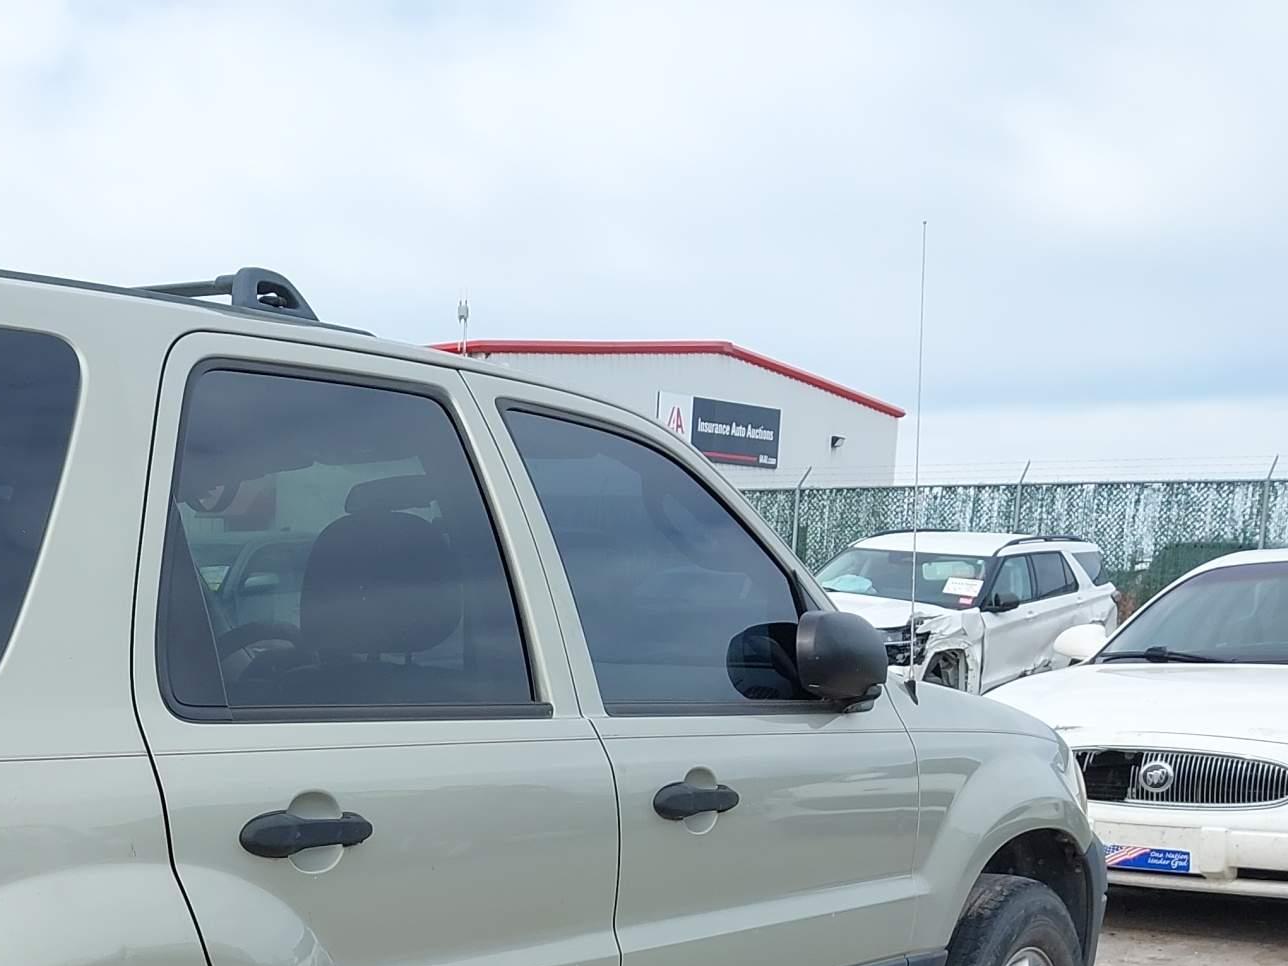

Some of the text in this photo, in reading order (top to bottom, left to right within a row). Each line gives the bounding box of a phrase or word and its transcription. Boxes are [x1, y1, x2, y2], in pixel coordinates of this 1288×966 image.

[697, 417, 774, 441] Insurance Auto Auctions
[1165, 852, 1188, 860] Nation
[1147, 857, 1189, 869] Under God
